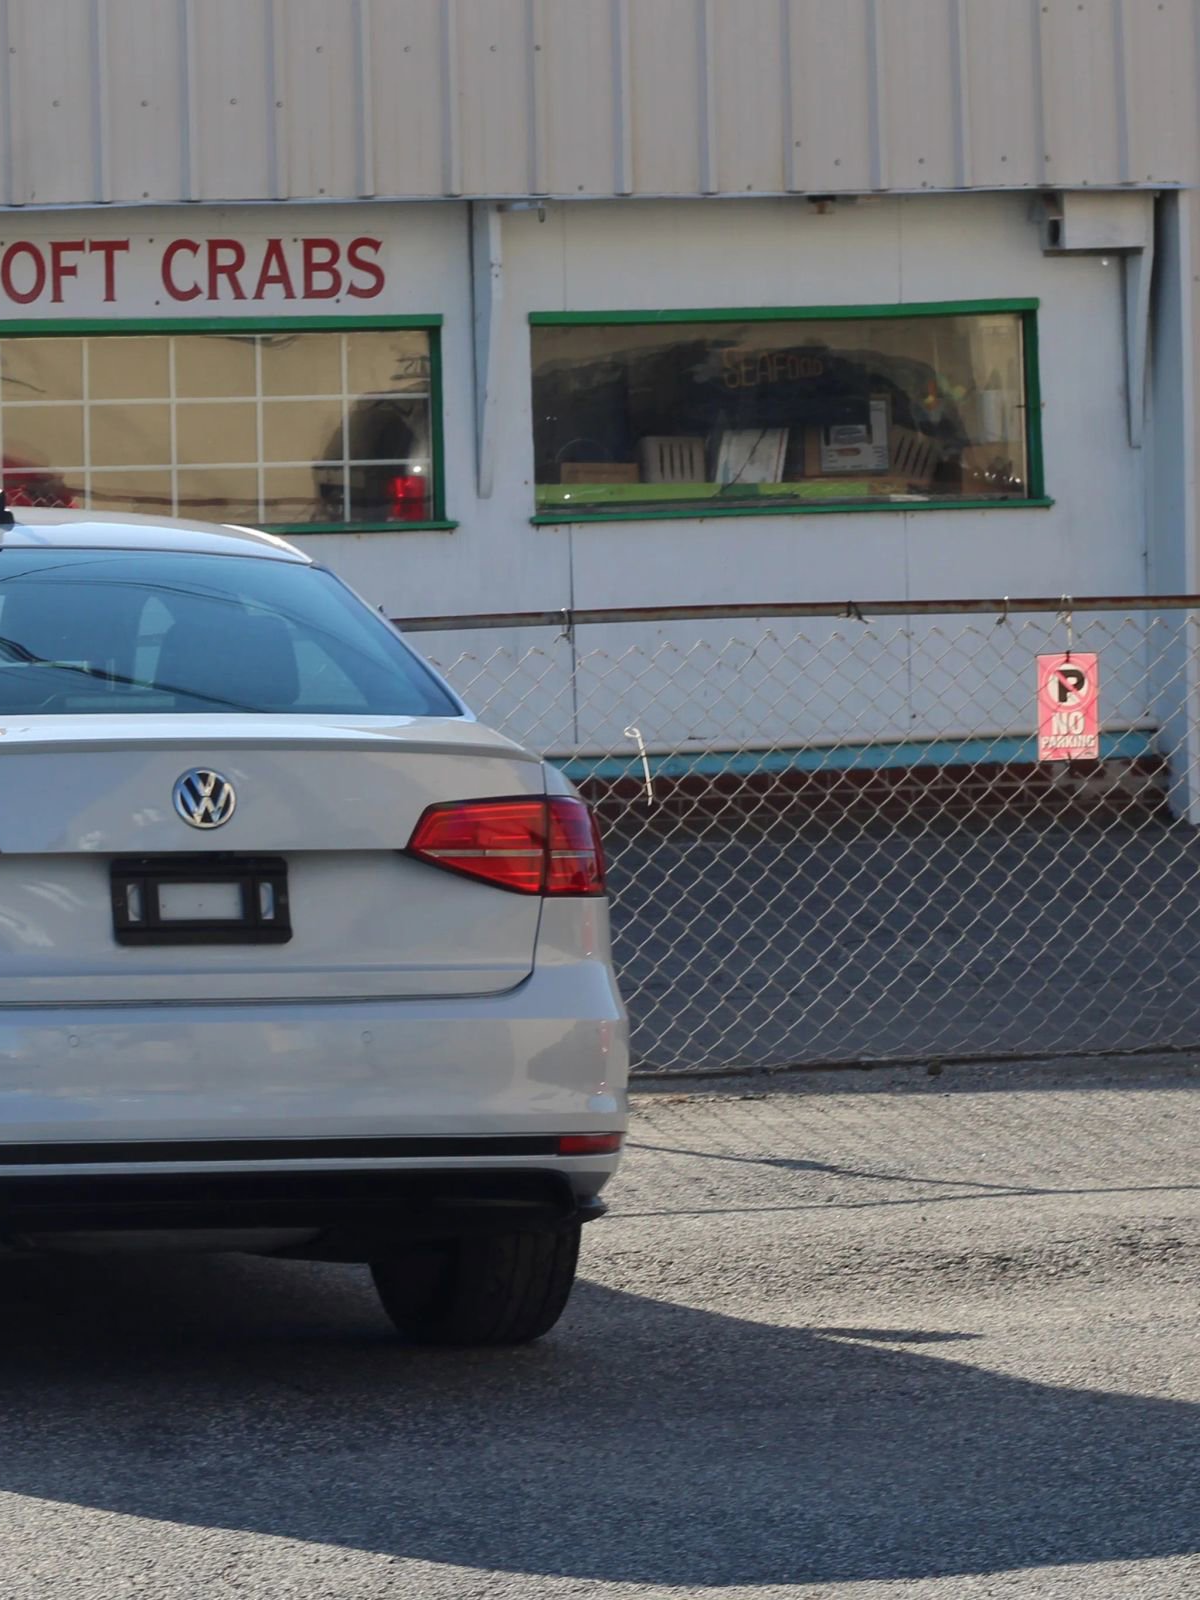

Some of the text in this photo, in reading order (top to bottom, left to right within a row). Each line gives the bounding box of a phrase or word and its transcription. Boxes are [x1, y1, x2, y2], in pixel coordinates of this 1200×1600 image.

[161, 237, 386, 302] CRABS
[1052, 711, 1086, 736] NO
[1042, 734, 1095, 750] PARKING
